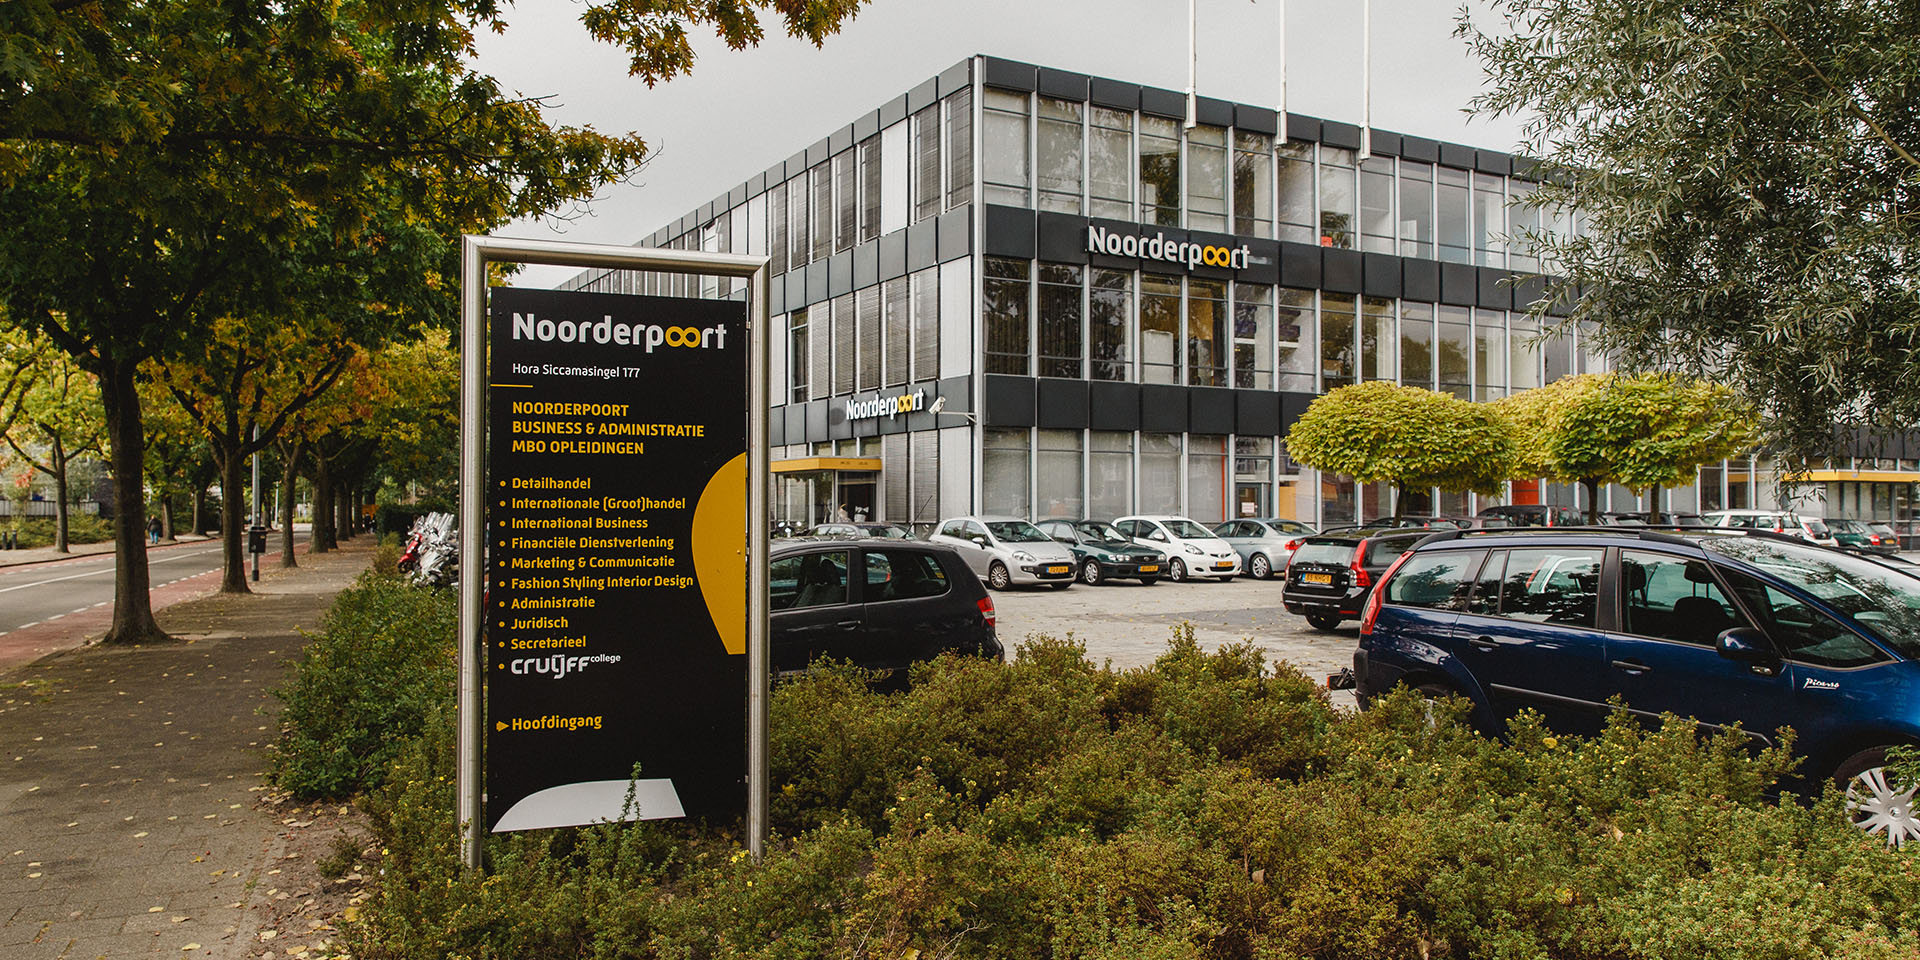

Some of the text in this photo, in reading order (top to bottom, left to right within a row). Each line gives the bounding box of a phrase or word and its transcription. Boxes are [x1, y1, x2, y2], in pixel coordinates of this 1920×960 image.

[1088, 225, 1250, 271] Noorderpoort
[512, 312, 727, 353] Noorderpoort
[512, 363, 641, 379] Hora Siccamasingel 177
[512, 401, 630, 417] NOORDERPOORT
[846, 388, 924, 420] Noorderpoort
[512, 421, 705, 437] BUSINESS & ADMINISTRATIE
[512, 440, 645, 455] MBO OPLEIDINGEN
[512, 477, 591, 489] Detailhandel
[511, 496, 686, 512] Internationale (Groot)handel
[511, 517, 649, 529] International Business
[511, 536, 675, 551] Financiële Dienstverlening
[511, 555, 675, 571] Marketing & Communicatie
[511, 575, 694, 591] Fashion Styling Interior Design
[511, 596, 596, 610] Administratie
[511, 616, 569, 630] Juridisch
[511, 635, 587, 650] Secretarieel
[590, 653, 622, 664] college
[1803, 677, 1840, 689] Picasso
[512, 715, 603, 732] Hoofdingang
